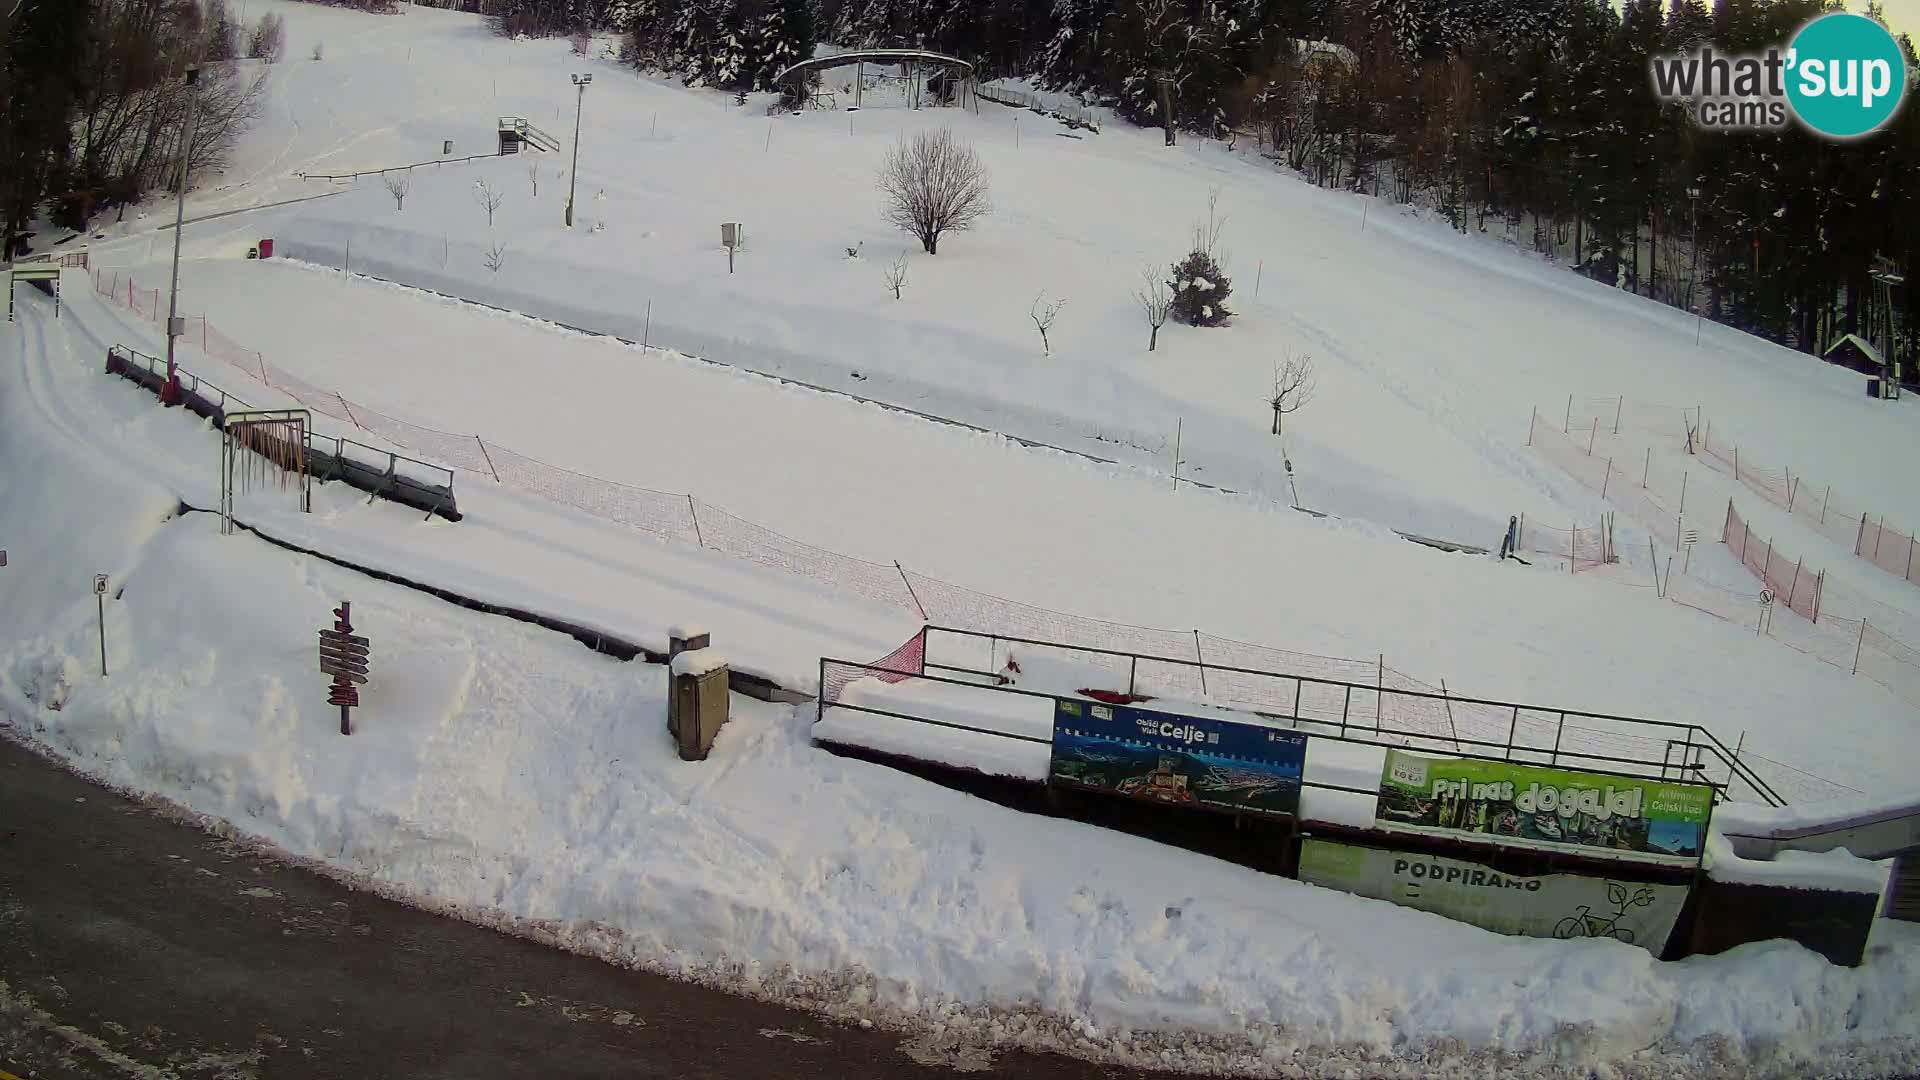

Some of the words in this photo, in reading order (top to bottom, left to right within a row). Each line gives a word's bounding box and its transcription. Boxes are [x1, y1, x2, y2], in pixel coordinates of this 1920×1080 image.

[1142, 726, 1158, 736] Visit
[1160, 722, 1205, 744] Celje
[1431, 777, 1468, 801] Pri
[1471, 781, 1515, 801] nas
[1515, 782, 1642, 820] dogaja!
[1393, 858, 1542, 892] PODPIRAMO
